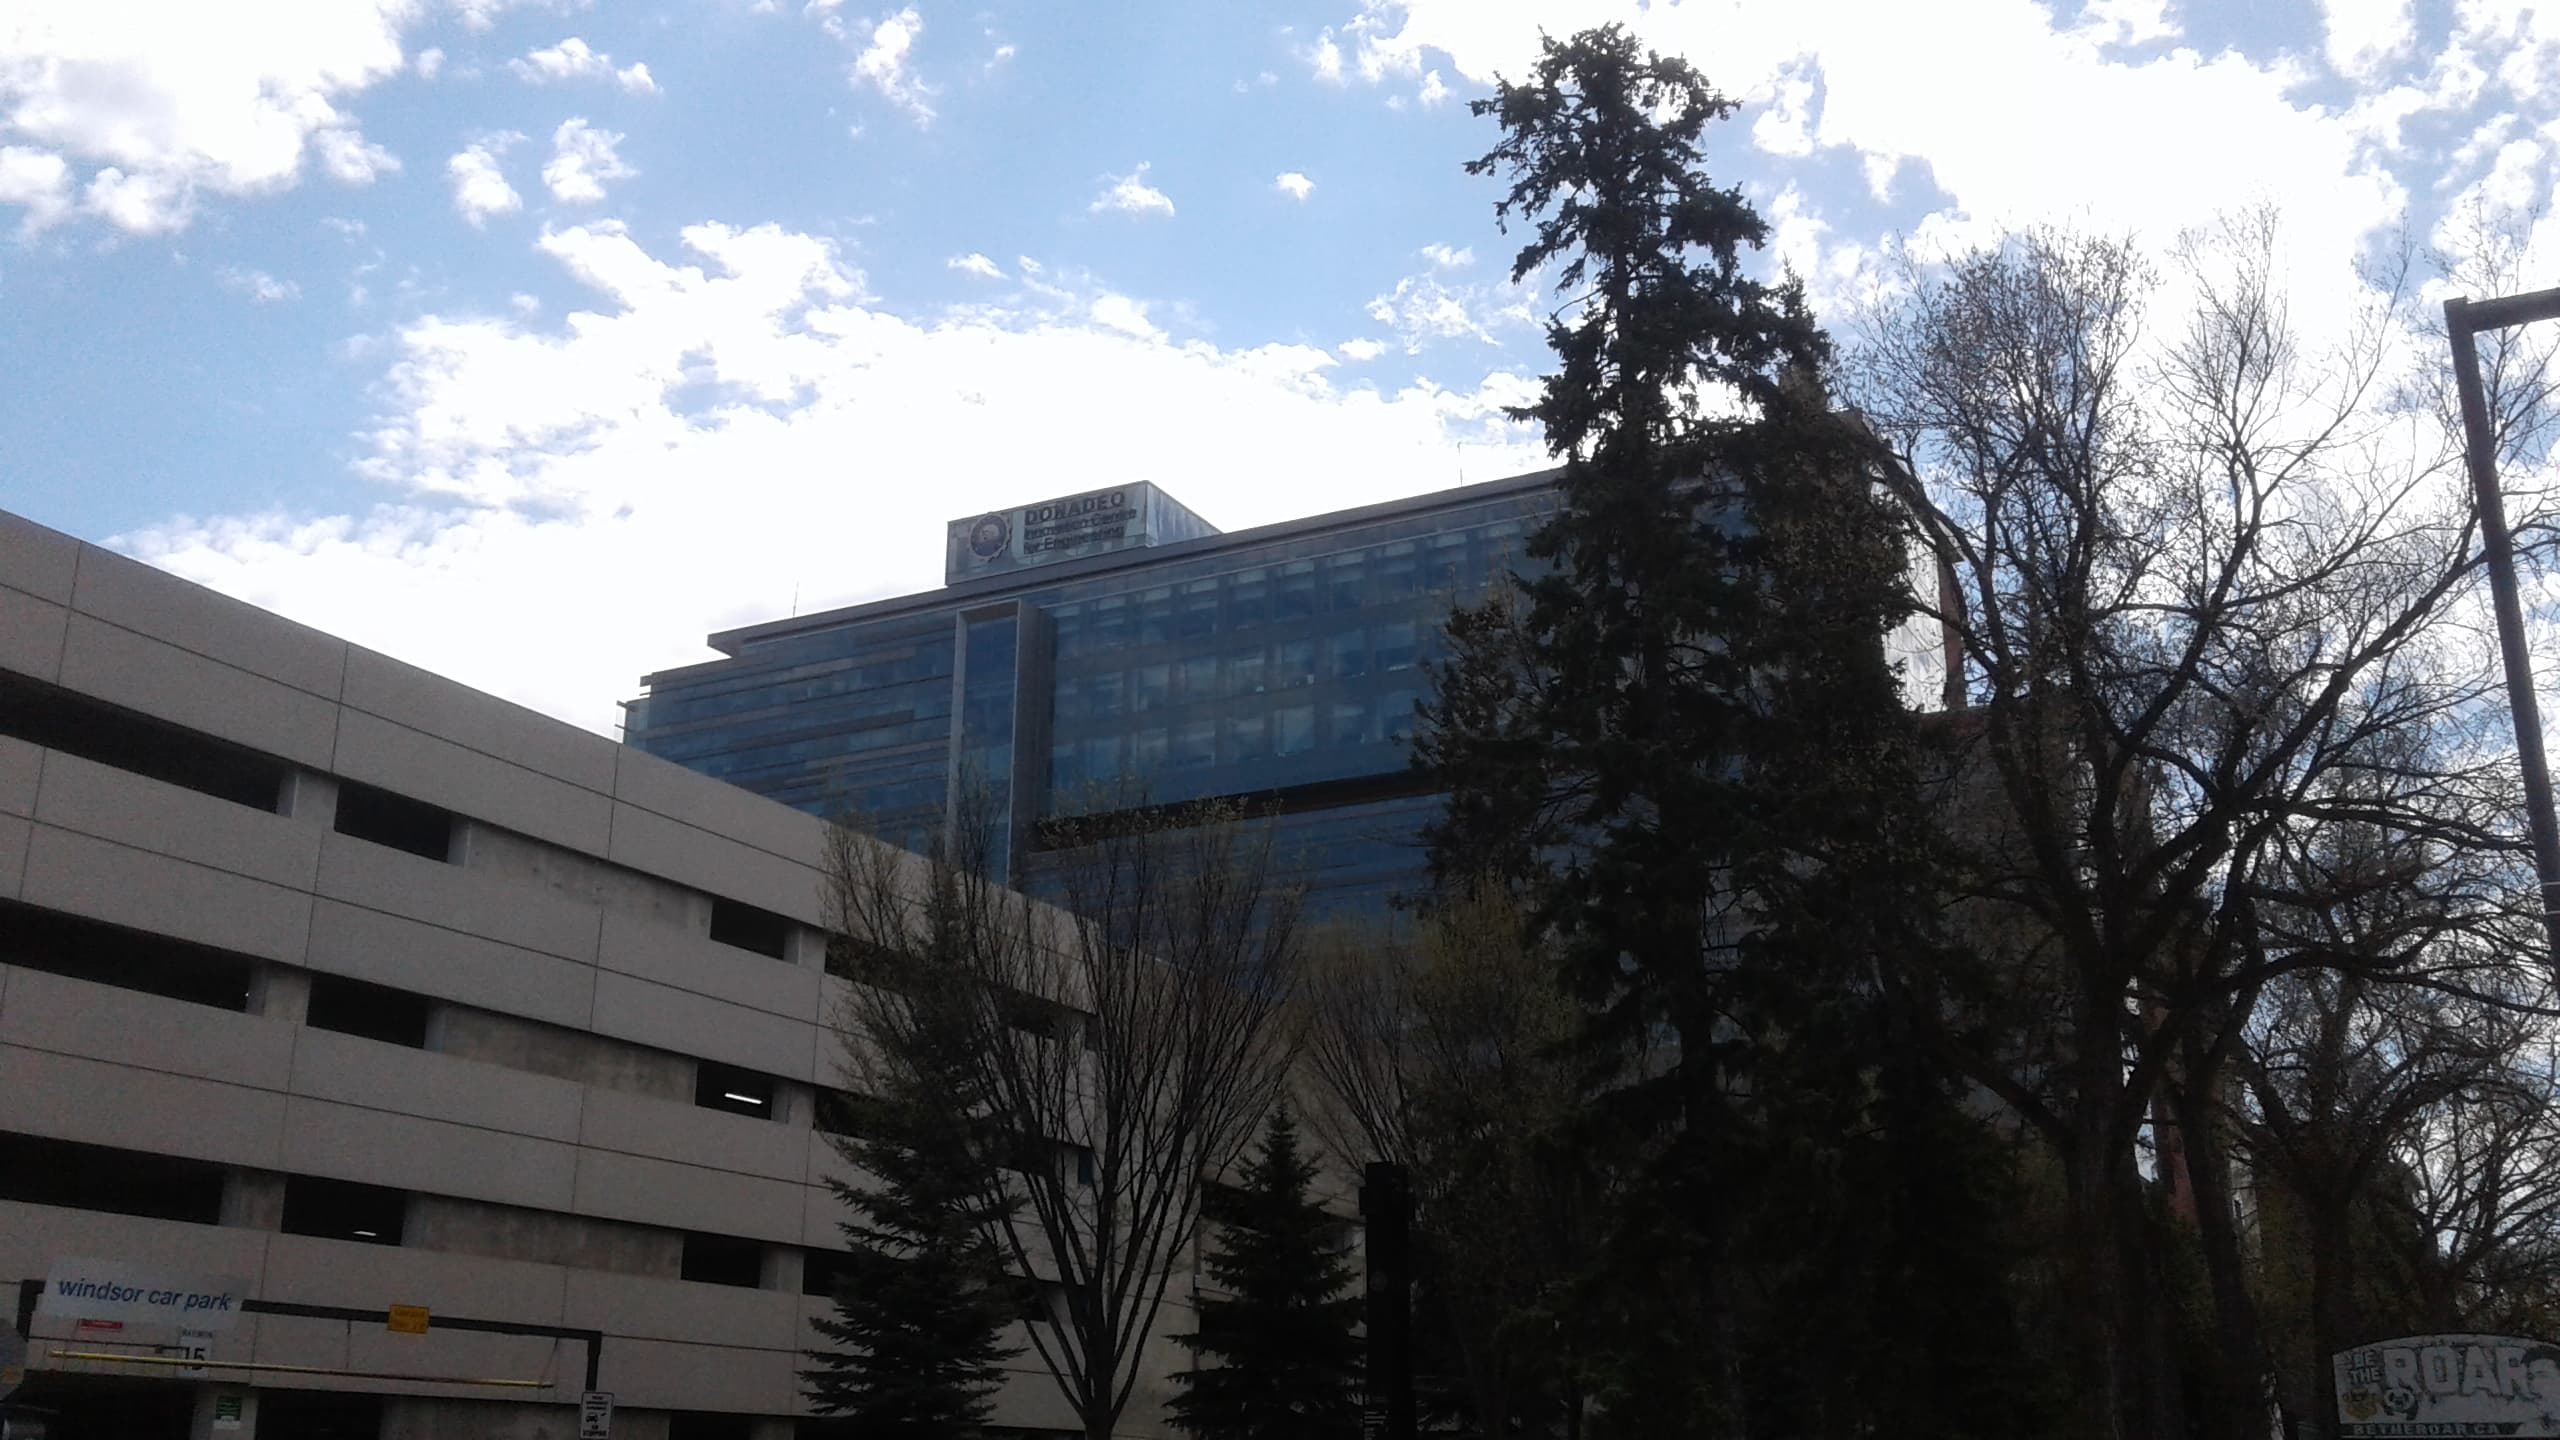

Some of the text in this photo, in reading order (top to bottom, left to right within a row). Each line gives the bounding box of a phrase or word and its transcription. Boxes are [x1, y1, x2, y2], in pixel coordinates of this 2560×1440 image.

[1024, 491, 1125, 525] DONADEO
[59, 1278, 232, 1312] windsor car park
[2351, 1349, 2378, 1368] BE
[2382, 1345, 2537, 1399] ROAR
[2349, 1367, 2382, 1385] THE
